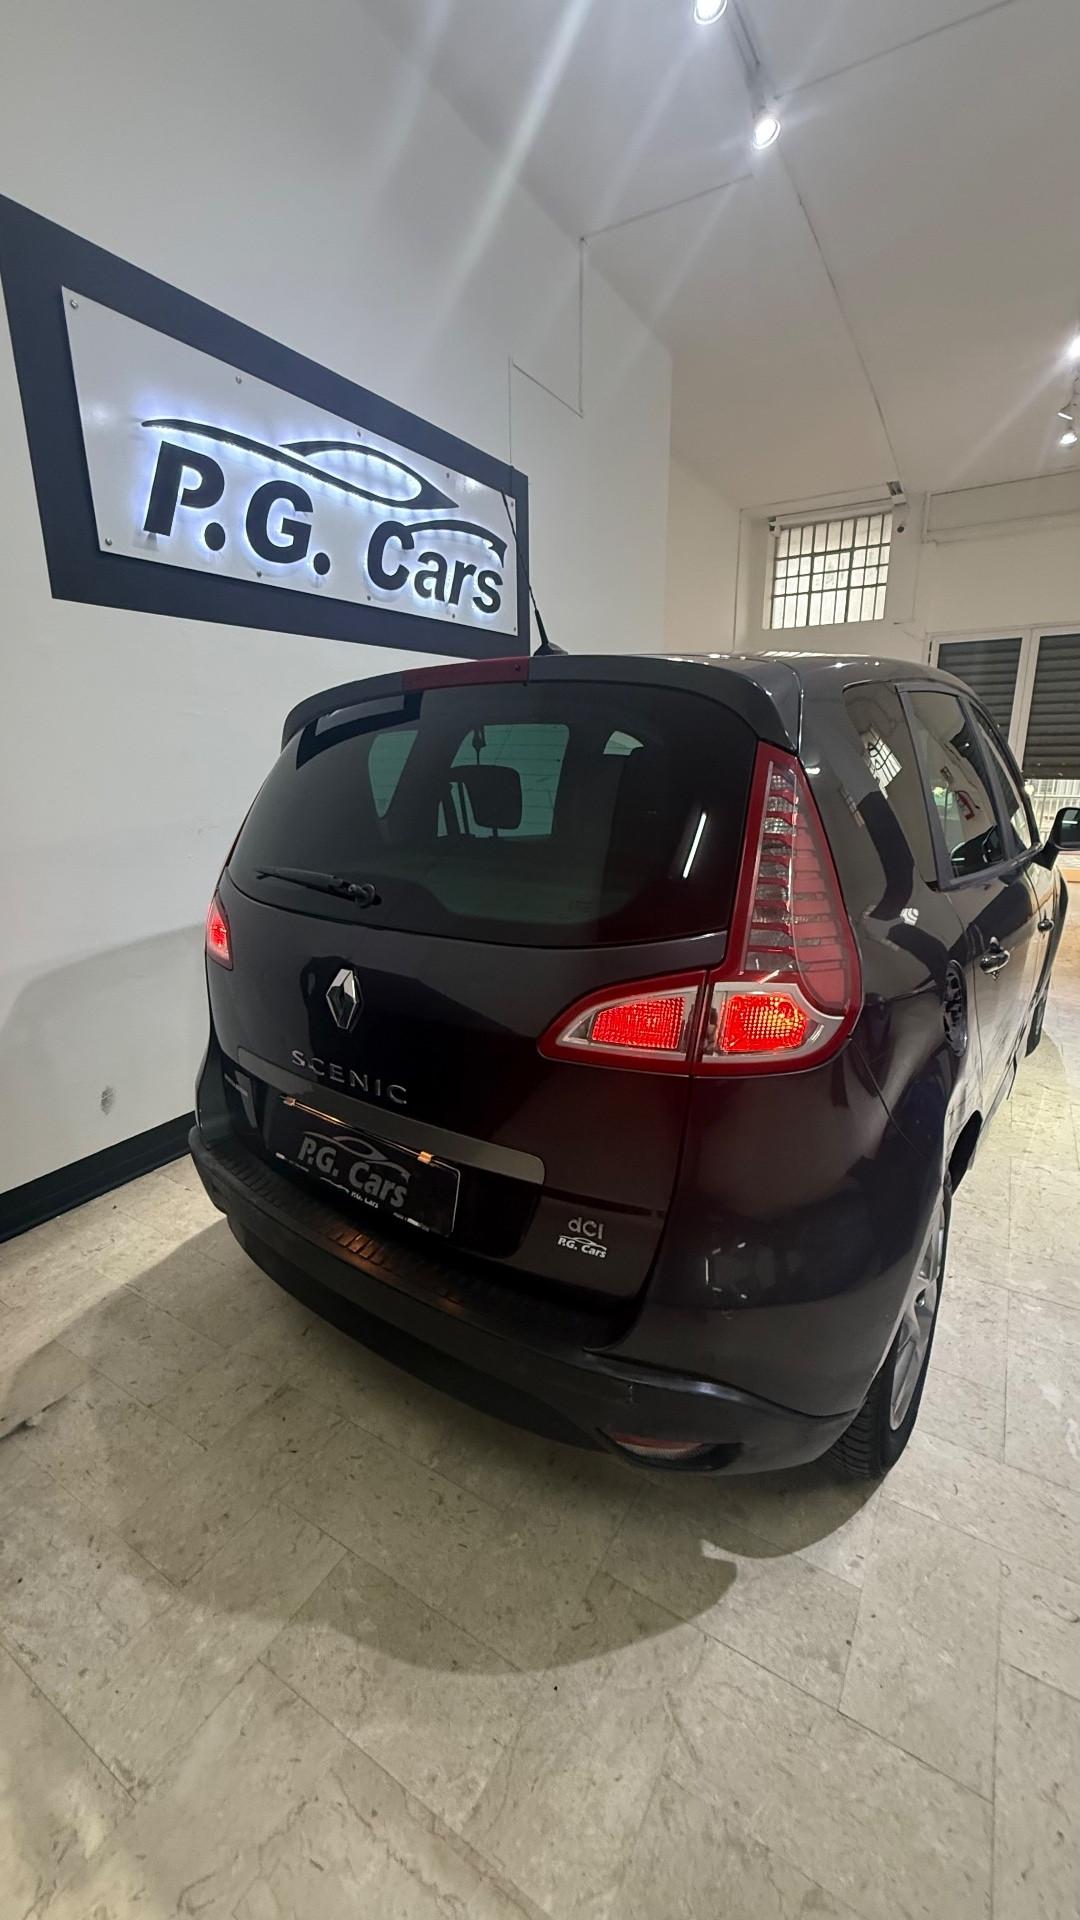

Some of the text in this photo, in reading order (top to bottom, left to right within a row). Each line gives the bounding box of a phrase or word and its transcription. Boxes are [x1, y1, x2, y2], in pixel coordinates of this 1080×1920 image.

[143, 440, 504, 614] P.G. Cars
[291, 1049, 407, 1104] SCENIC
[298, 1136, 340, 1177] P.G.
[349, 1161, 408, 1208] Cars
[558, 1237, 607, 1258] P.G. Cars
